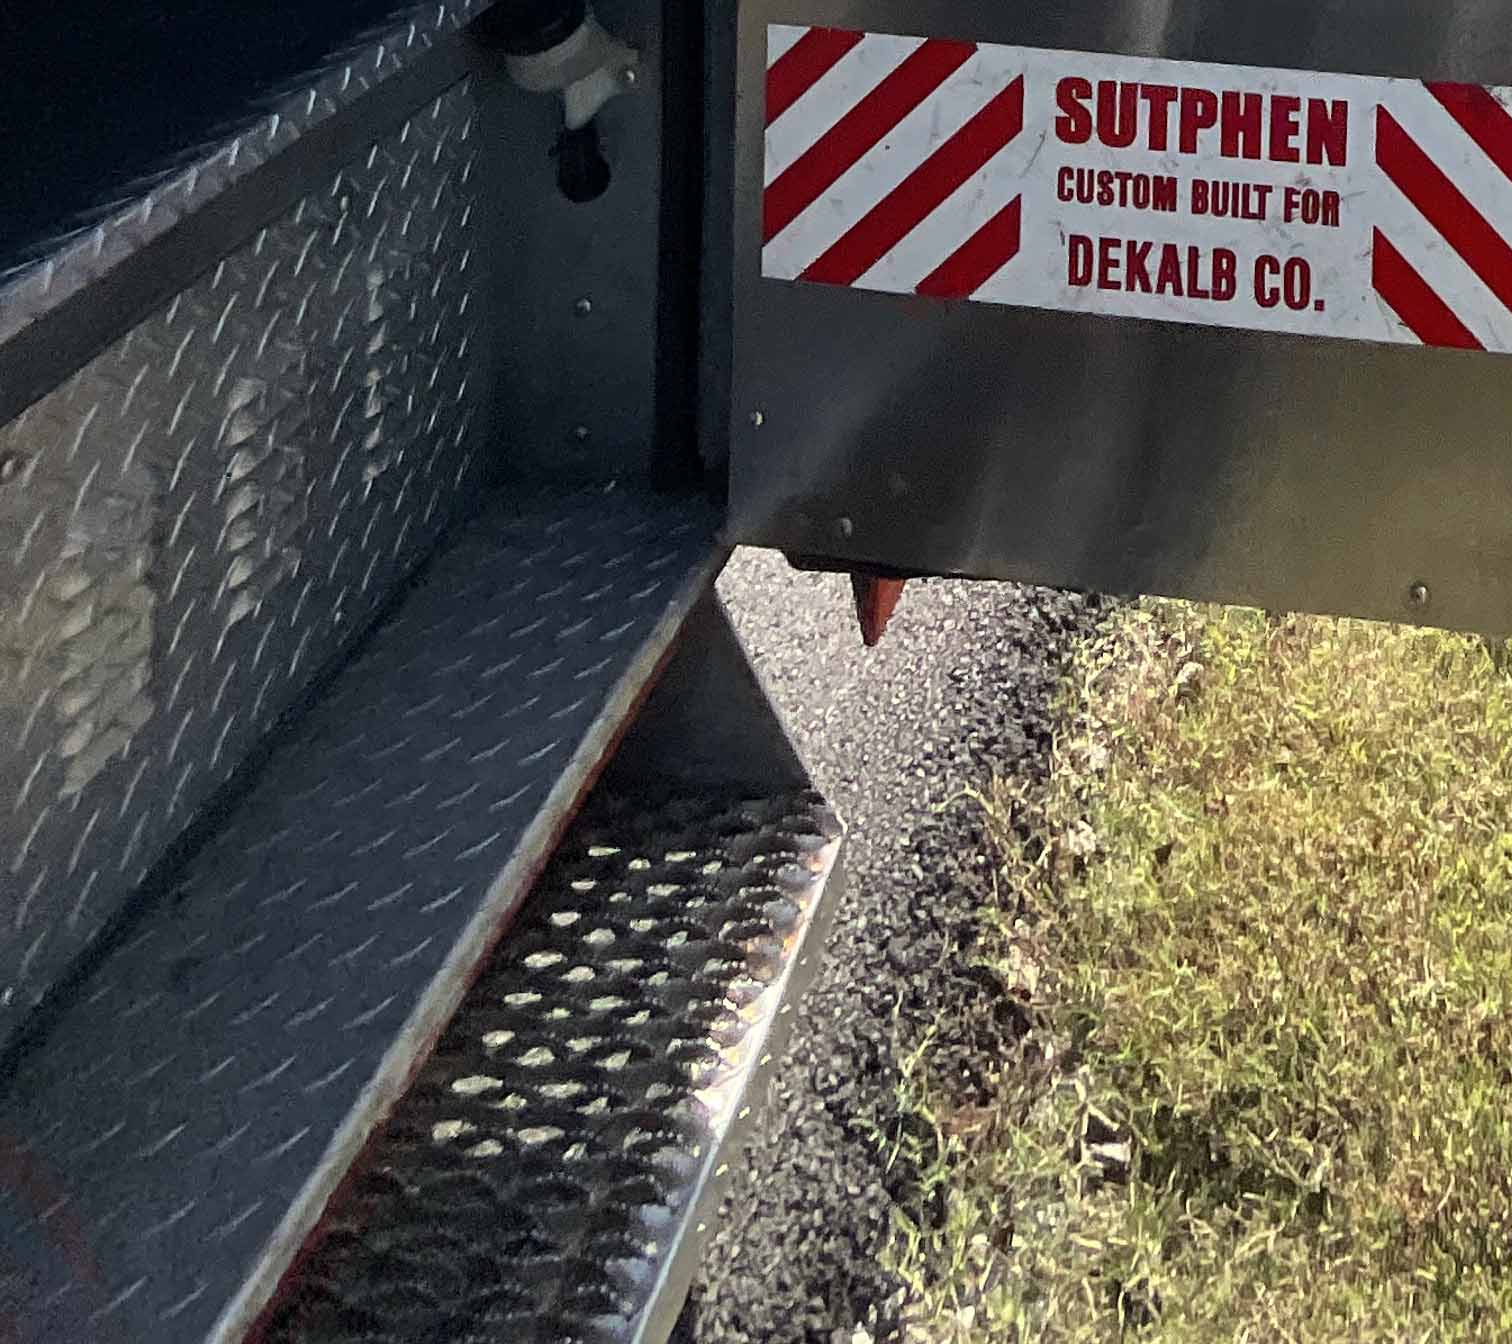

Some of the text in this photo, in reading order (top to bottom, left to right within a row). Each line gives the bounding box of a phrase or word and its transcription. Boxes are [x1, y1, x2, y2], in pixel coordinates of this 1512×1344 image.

[1055, 76, 1348, 167] SUTPHEN
[1057, 166, 1341, 227] CUSTOM BUILT FOR
[1068, 234, 1325, 312] DEKALB CO.
